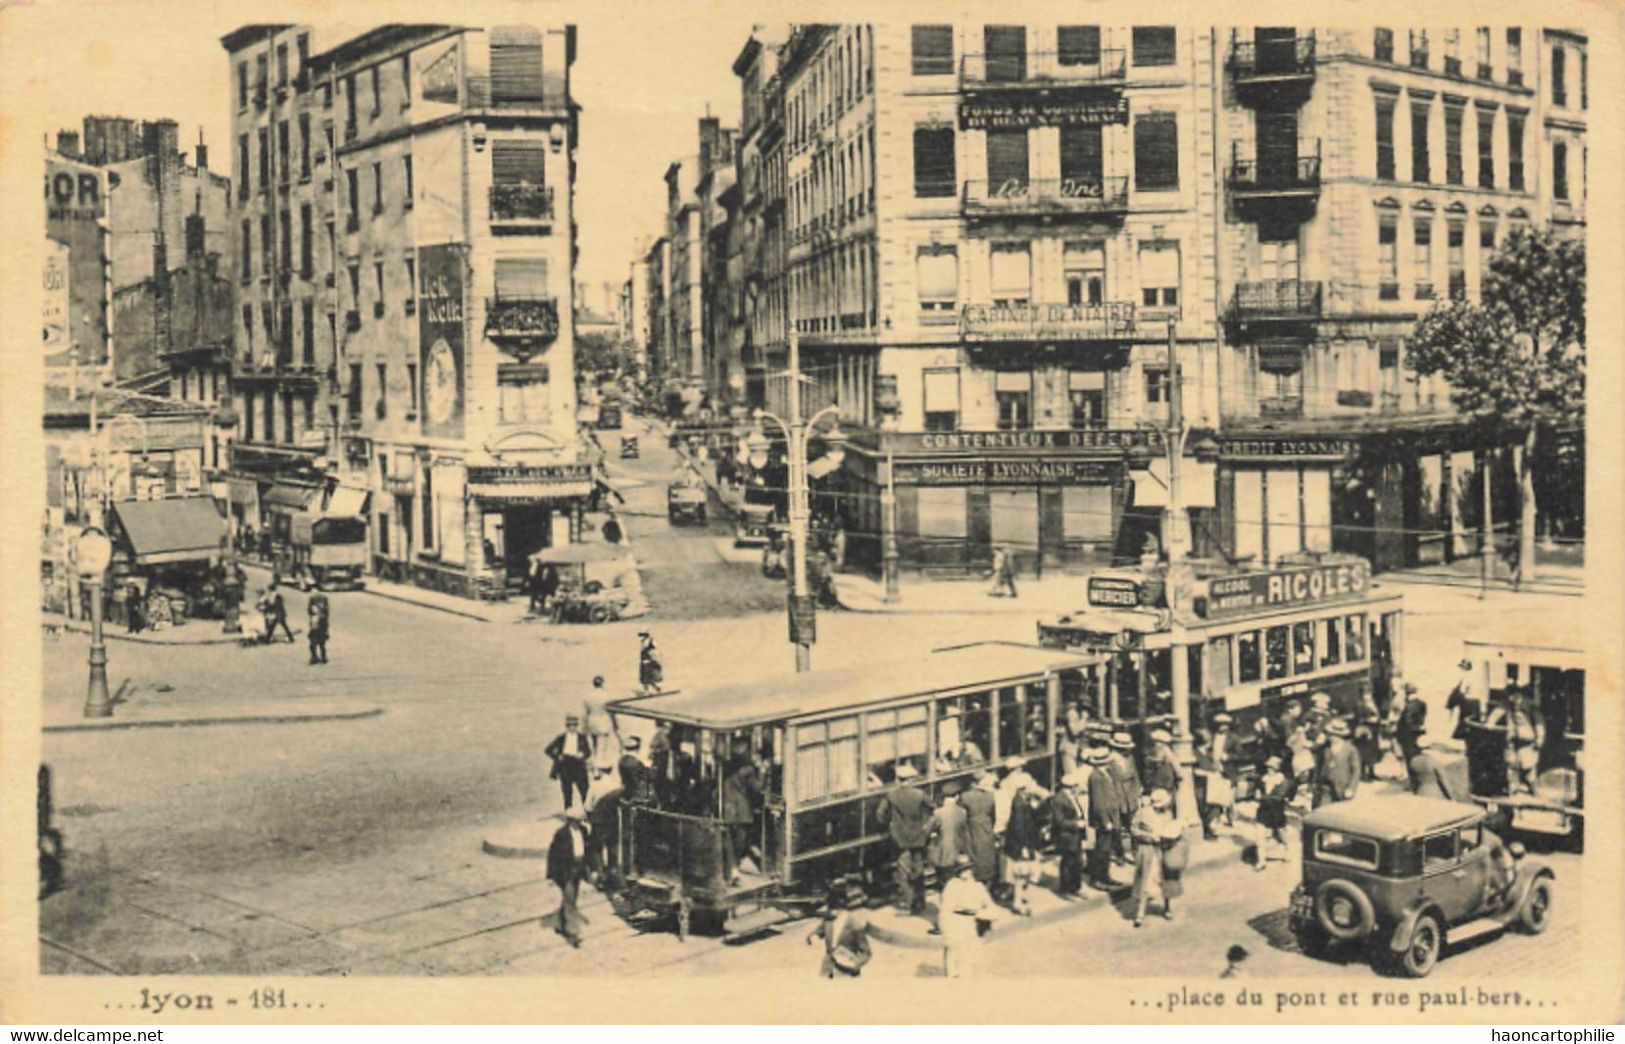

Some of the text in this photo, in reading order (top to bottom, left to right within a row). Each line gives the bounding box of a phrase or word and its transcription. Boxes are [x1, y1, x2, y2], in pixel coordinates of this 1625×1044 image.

[45, 171, 99, 205] OR
[966, 301, 1135, 322] CABINET DENTAIRE
[922, 433, 1054, 448] CONTENTIEUX
[1222, 441, 1276, 454] CREDIT
[993, 461, 1076, 477] LYONNAISE
[1268, 564, 1365, 603] RICOLES
[1090, 589, 1137, 604] MERCIER
